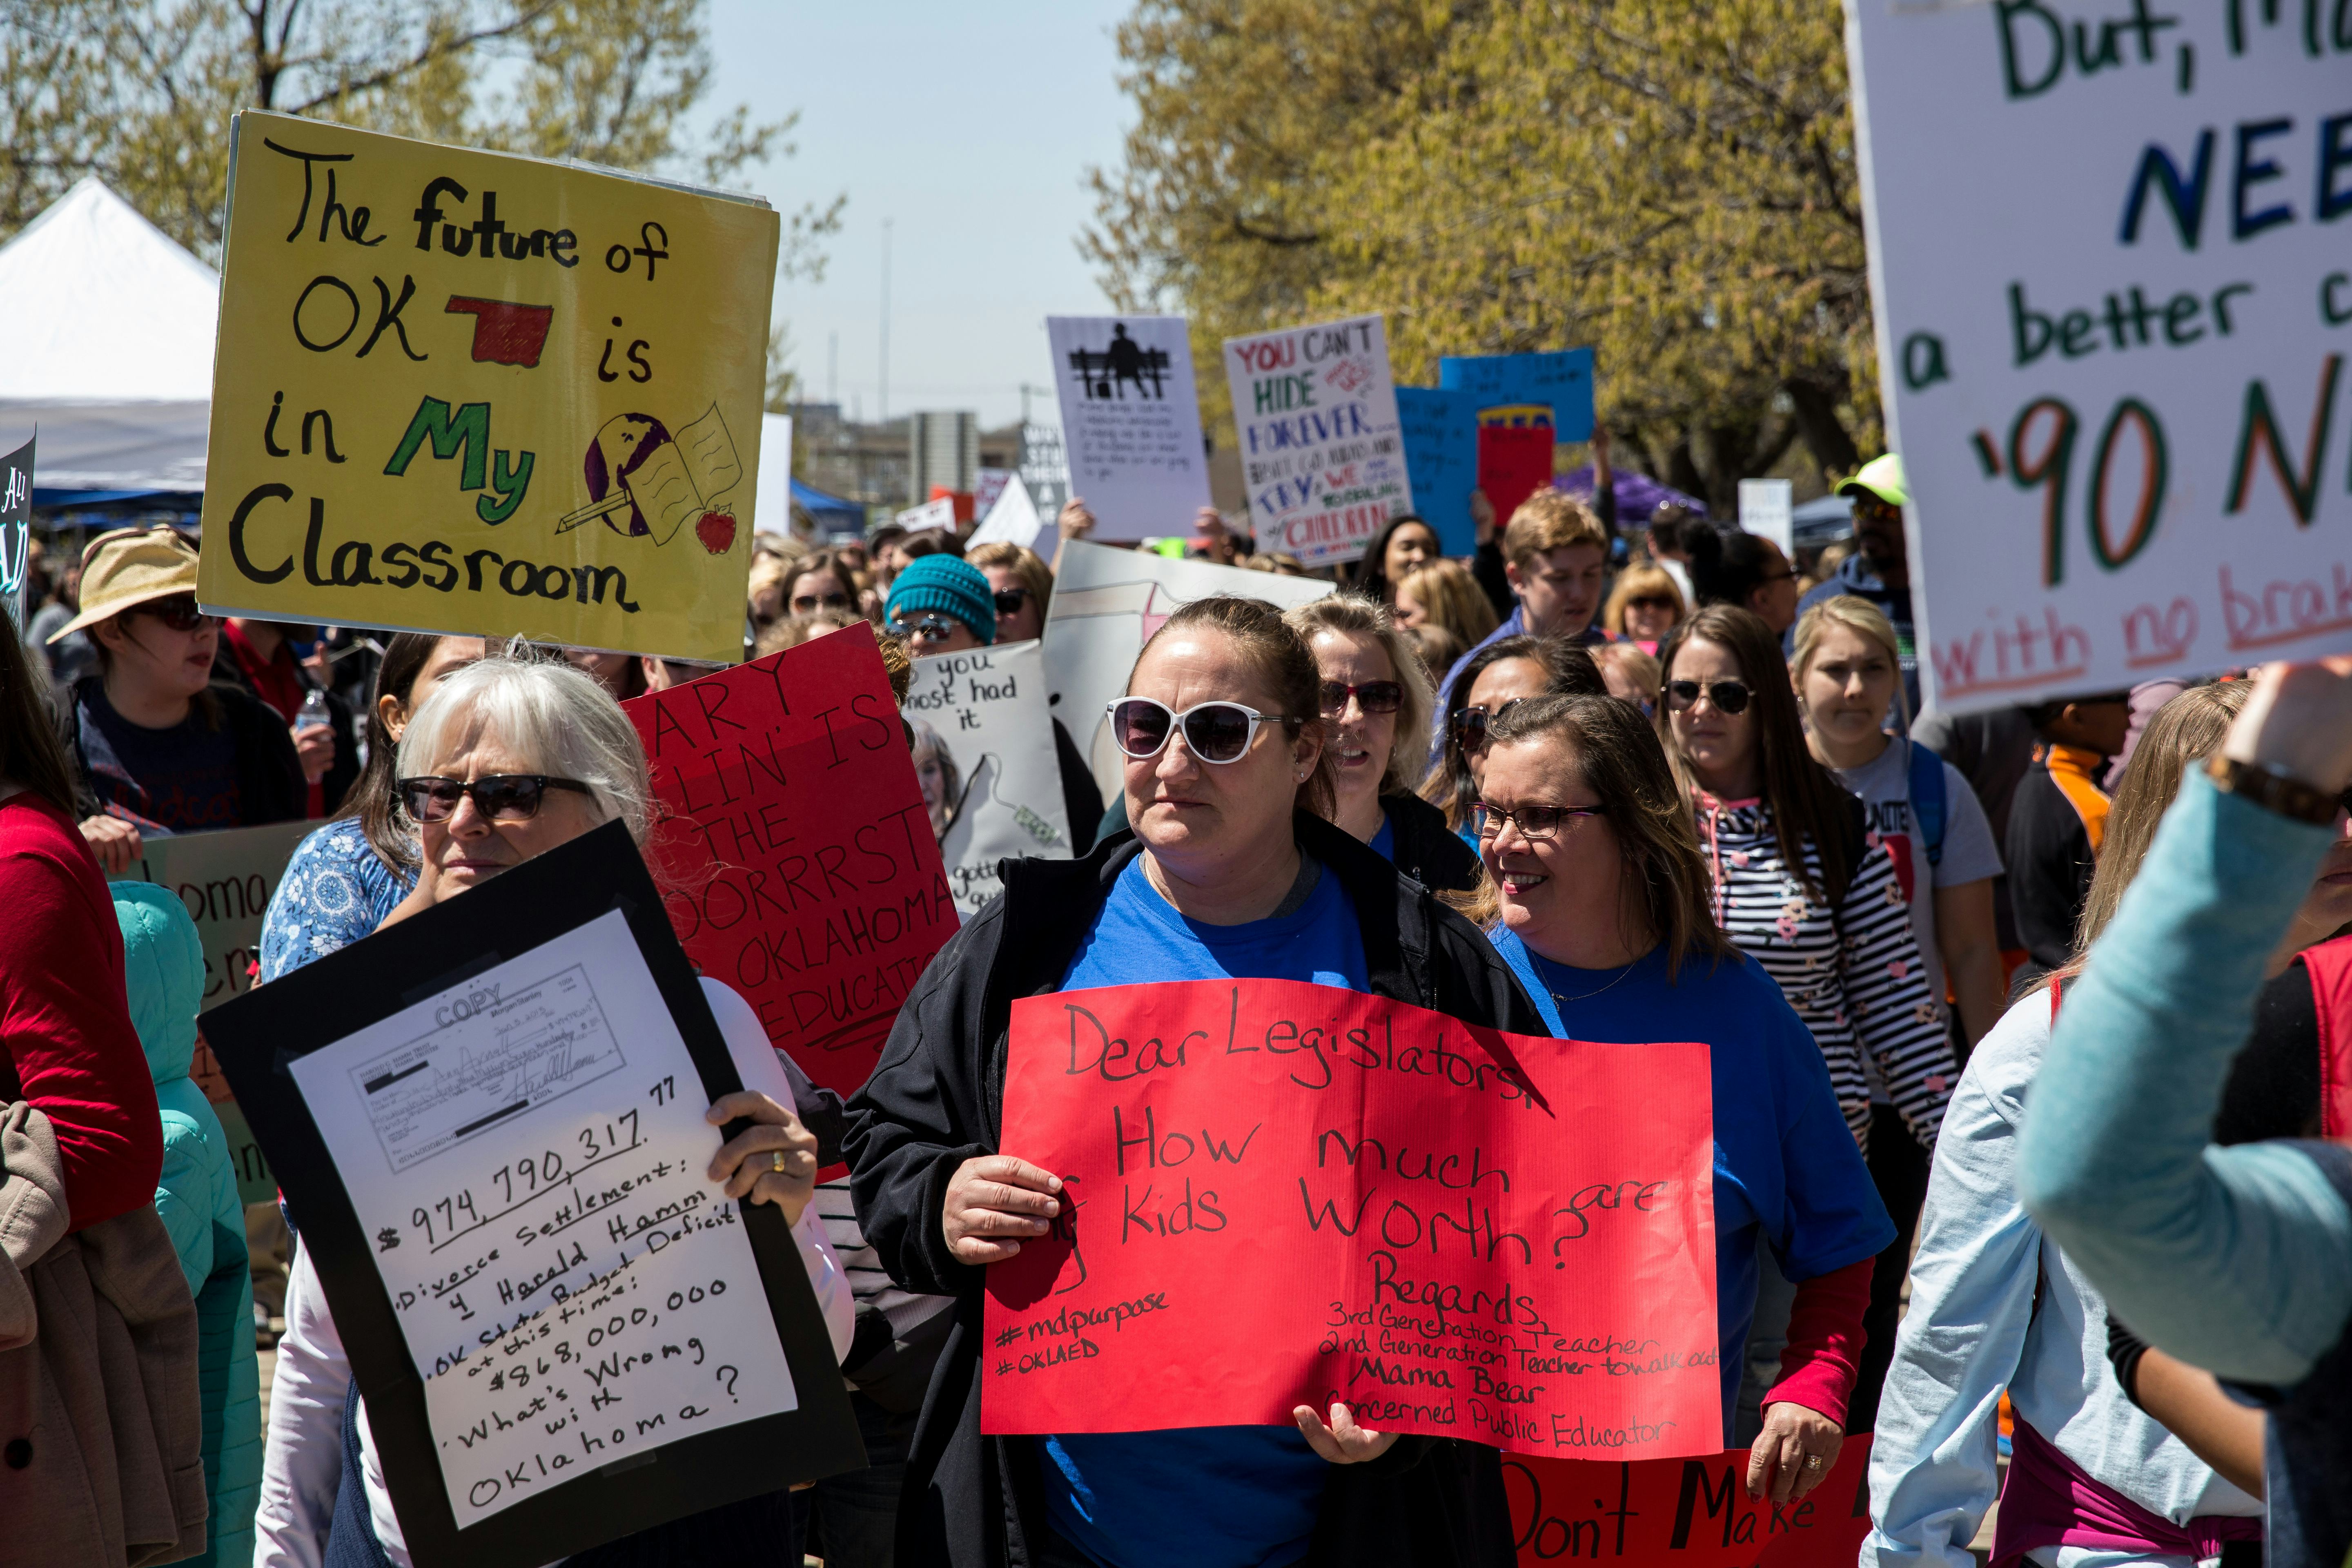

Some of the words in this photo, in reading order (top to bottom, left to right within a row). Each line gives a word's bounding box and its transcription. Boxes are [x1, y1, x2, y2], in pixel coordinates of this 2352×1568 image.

[264, 138, 386, 245] The
[414, 177, 578, 268] future
[606, 223, 668, 281] of
[294, 274, 428, 362] OK
[598, 316, 651, 383] is
[1235, 337, 1296, 374] YOU
[1304, 322, 1372, 363] CAN'T
[1902, 330, 1949, 390] a
[2008, 271, 2256, 367] better
[1254, 370, 1317, 415] HIDE
[1, 467, 26, 513] All
[264, 391, 347, 463] in
[384, 395, 535, 524] My
[1970, 395, 2169, 588] '90
[2221, 352, 2352, 530] N
[229, 483, 641, 612] Classroom
[937, 653, 993, 688] you
[1930, 604, 2093, 690] with
[2125, 596, 2197, 657] no
[653, 652, 791, 757] ARY
[813, 694, 890, 770] IS
[956, 708, 981, 731] it
[969, 675, 1017, 702] had
[662, 802, 922, 942] OORRRST
[691, 803, 795, 869] THE
[142, 859, 270, 922] oma
[738, 873, 957, 988] OKLAHOMA
[435, 982, 503, 1028] COPY
[1064, 1003, 1209, 1082] Dear
[1226, 986, 1533, 1109] Legislators,
[1114, 1105, 1262, 1177] How
[1319, 1128, 1510, 1193] much
[398, 1249, 499, 1310] Divorce
[517, 1159, 686, 1247] Settlement:
[608, 1190, 707, 1243] Hamm
[1122, 1176, 1227, 1245] Kids
[1299, 1176, 1589, 1271] Worth?
[1569, 1180, 1668, 1212] are
[436, 1345, 468, 1376] OK
[479, 1310, 546, 1348] State
[551, 1252, 634, 1305] Budget
[647, 1203, 735, 1254] Deficit
[468, 1355, 494, 1376] at
[504, 1322, 551, 1355] this
[560, 1276, 637, 1324] time:
[995, 1292, 1169, 1348] #mdpurpose
[1327, 1301, 1374, 1326] 3rd
[1379, 1303, 1517, 1349] Generation
[1522, 1329, 1660, 1355] Teacher
[1368, 1250, 1549, 1339] Regards,
[490, 1279, 726, 1390] $868,000,000
[995, 1337, 1100, 1376] #OKLAED
[1319, 1330, 1370, 1354] 2nd
[1379, 1329, 1507, 1368] Generation
[1512, 1348, 1594, 1375] Teacher
[459, 1385, 568, 1448] What's
[584, 1337, 705, 1386] Wrong
[546, 1387, 622, 1434] with
[1324, 1390, 1457, 1425] Concerned
[1467, 1398, 1544, 1443] Public
[1551, 1413, 1677, 1448] Educator
[1348, 1356, 1456, 1389] Mama
[1467, 1366, 1546, 1404] Bear
[1500, 1461, 1639, 1559] Don't
[1669, 1460, 1814, 1550] Make
